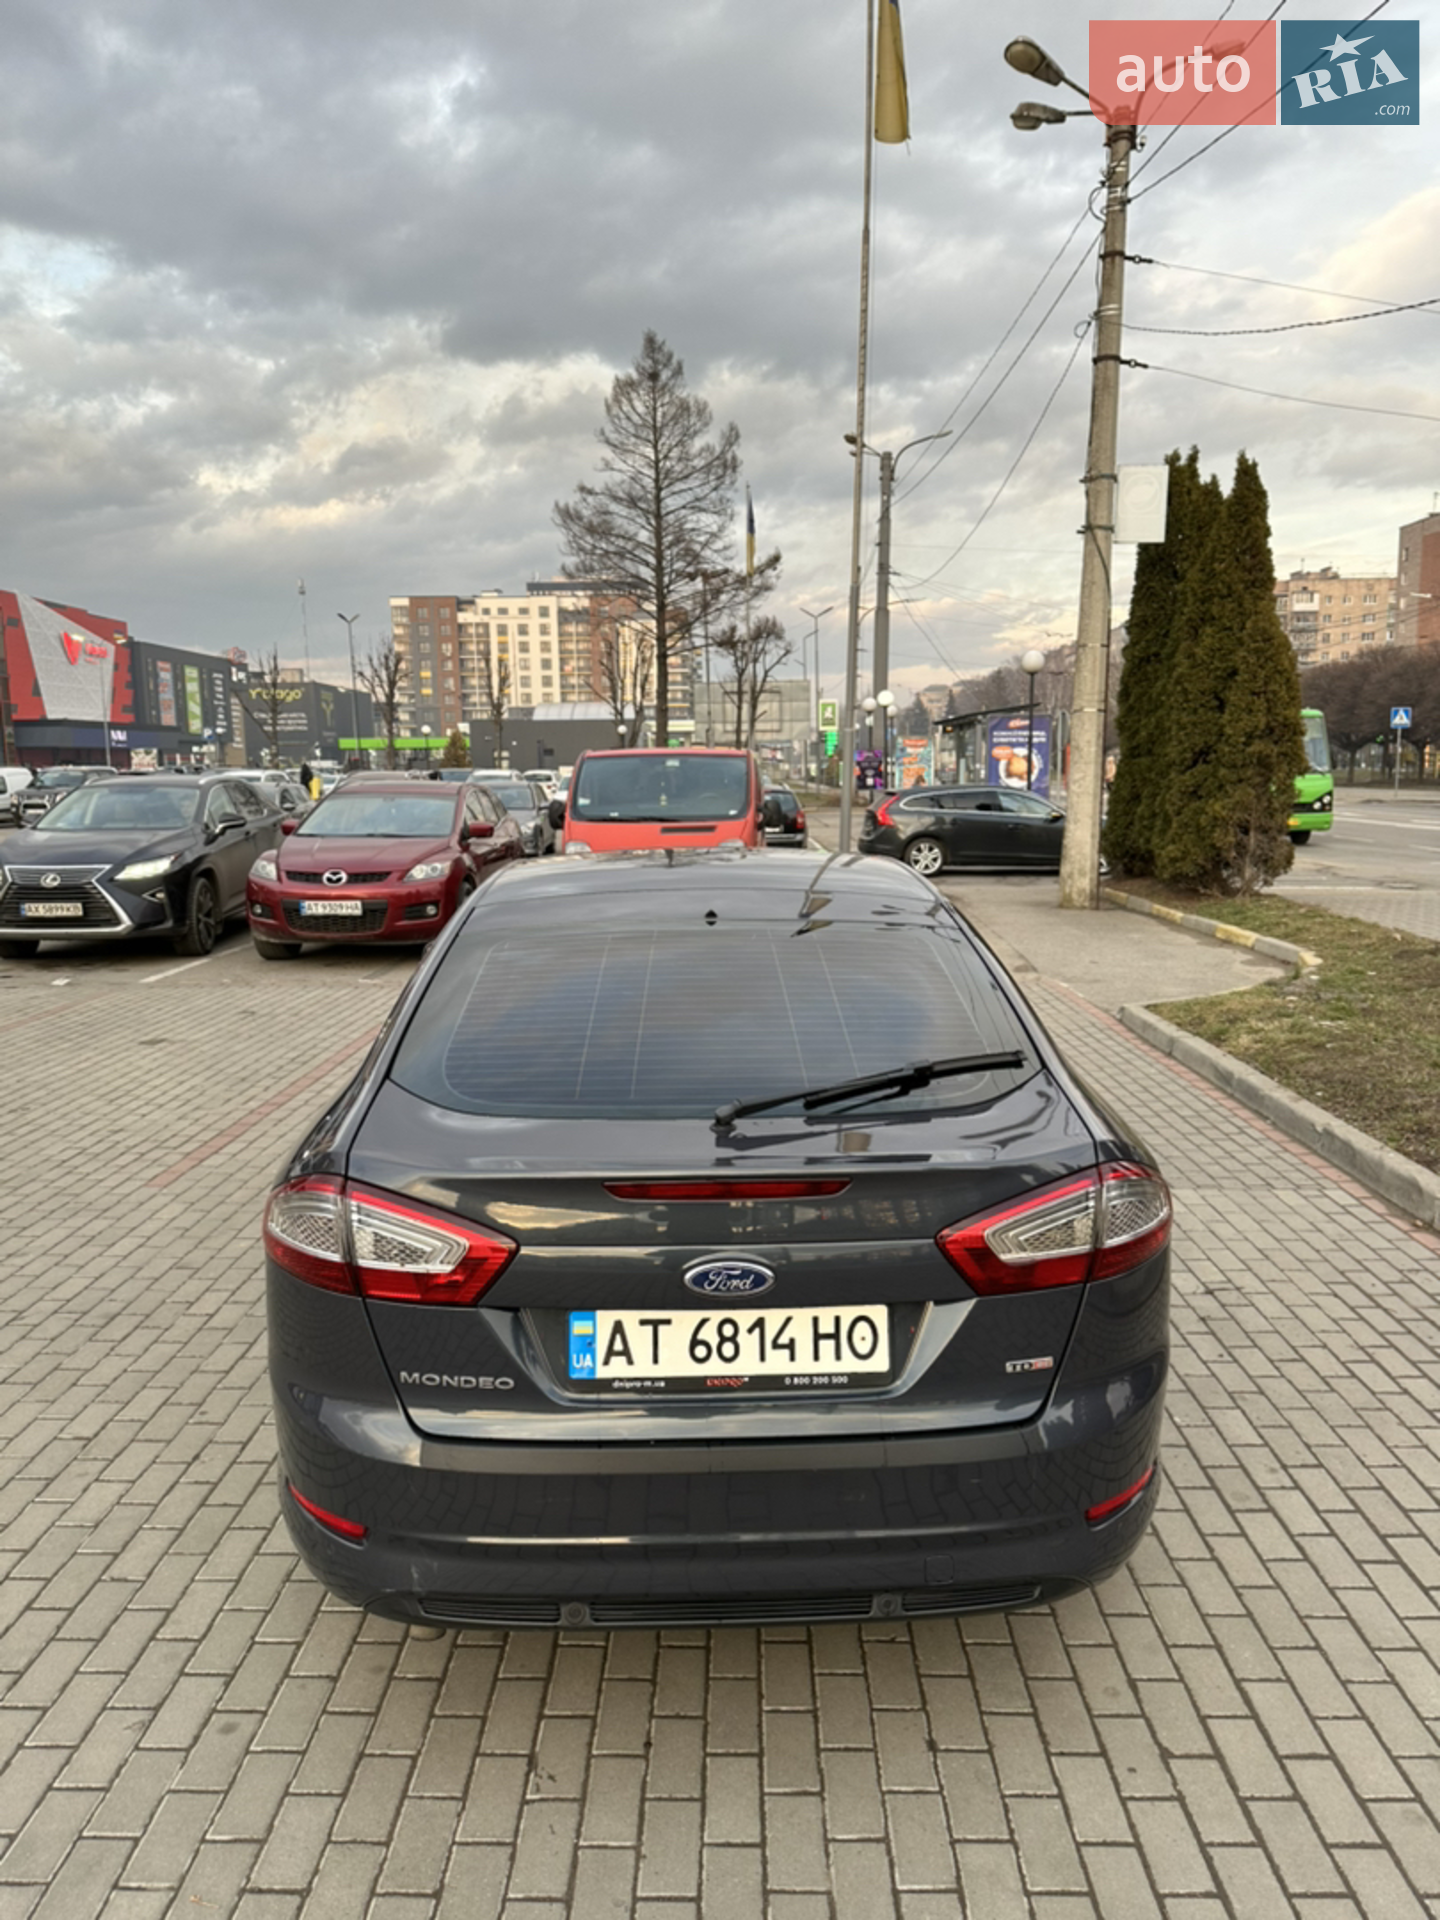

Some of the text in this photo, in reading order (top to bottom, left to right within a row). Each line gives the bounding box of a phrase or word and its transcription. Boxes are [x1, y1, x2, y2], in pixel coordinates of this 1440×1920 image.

[703, 1269, 755, 1292] Ford
[602, 1314, 879, 1366] AT 6814 HO
[573, 1353, 594, 1369] UA
[400, 1370, 515, 1390] MONDEO
